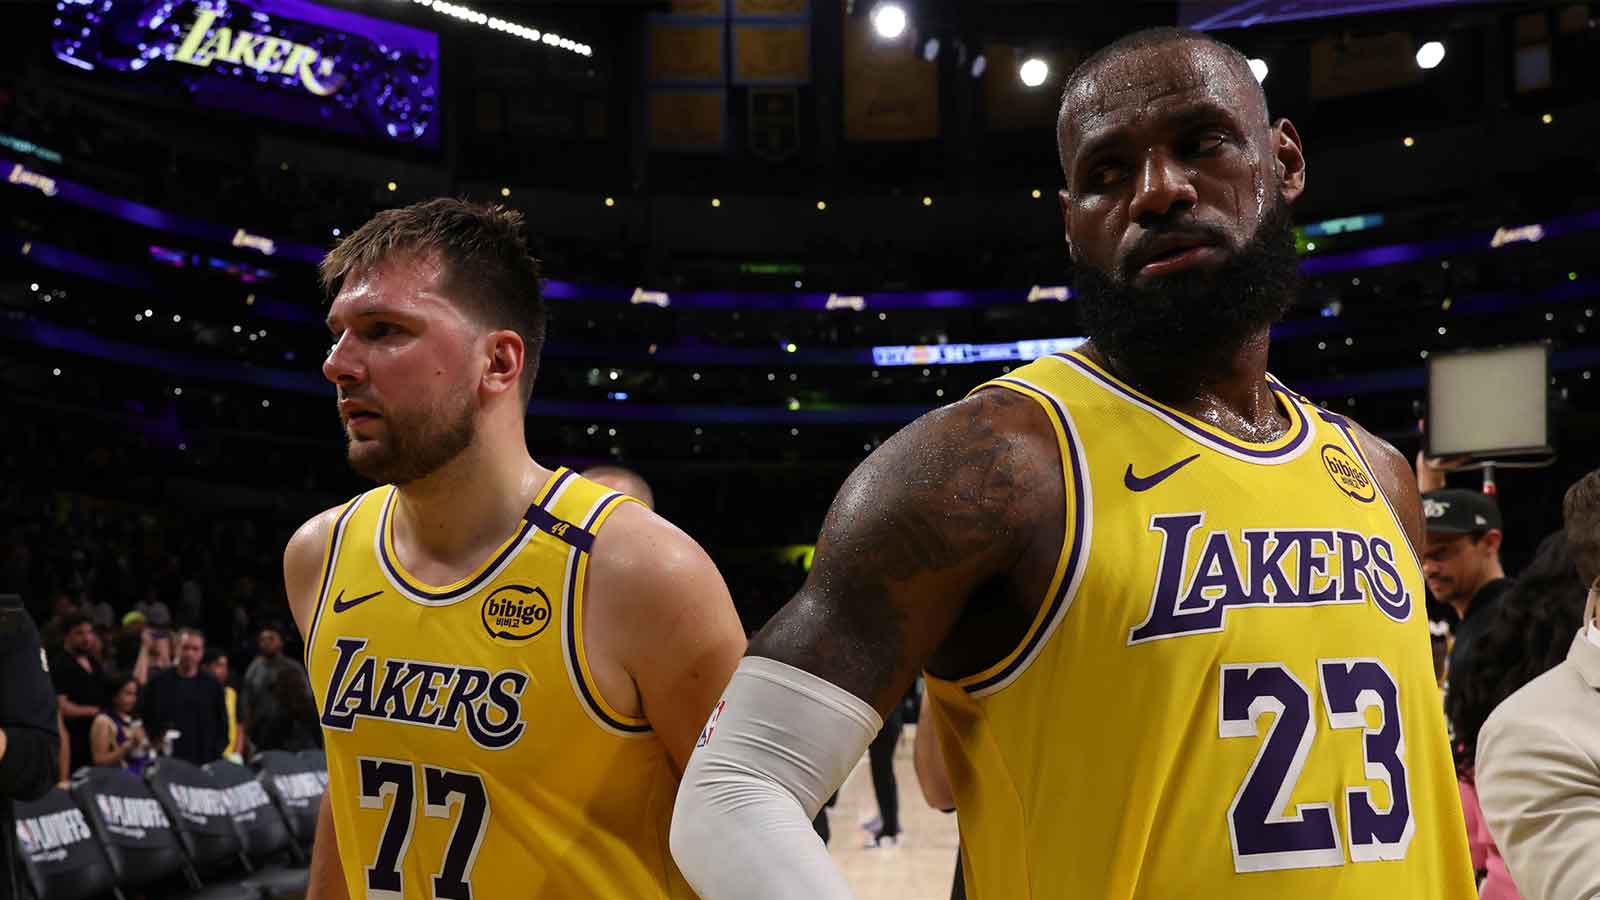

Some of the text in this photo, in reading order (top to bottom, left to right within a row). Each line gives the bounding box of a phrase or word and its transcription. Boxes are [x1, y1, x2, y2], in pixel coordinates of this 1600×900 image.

[1325, 455, 1369, 488] bibigo
[551, 522, 570, 537] 44
[1127, 513, 1414, 646] LAKERS
[488, 598, 547, 625] bibigo
[320, 637, 530, 750] LAKERS
[1218, 658, 1415, 873] 23
[357, 757, 491, 900] 77
